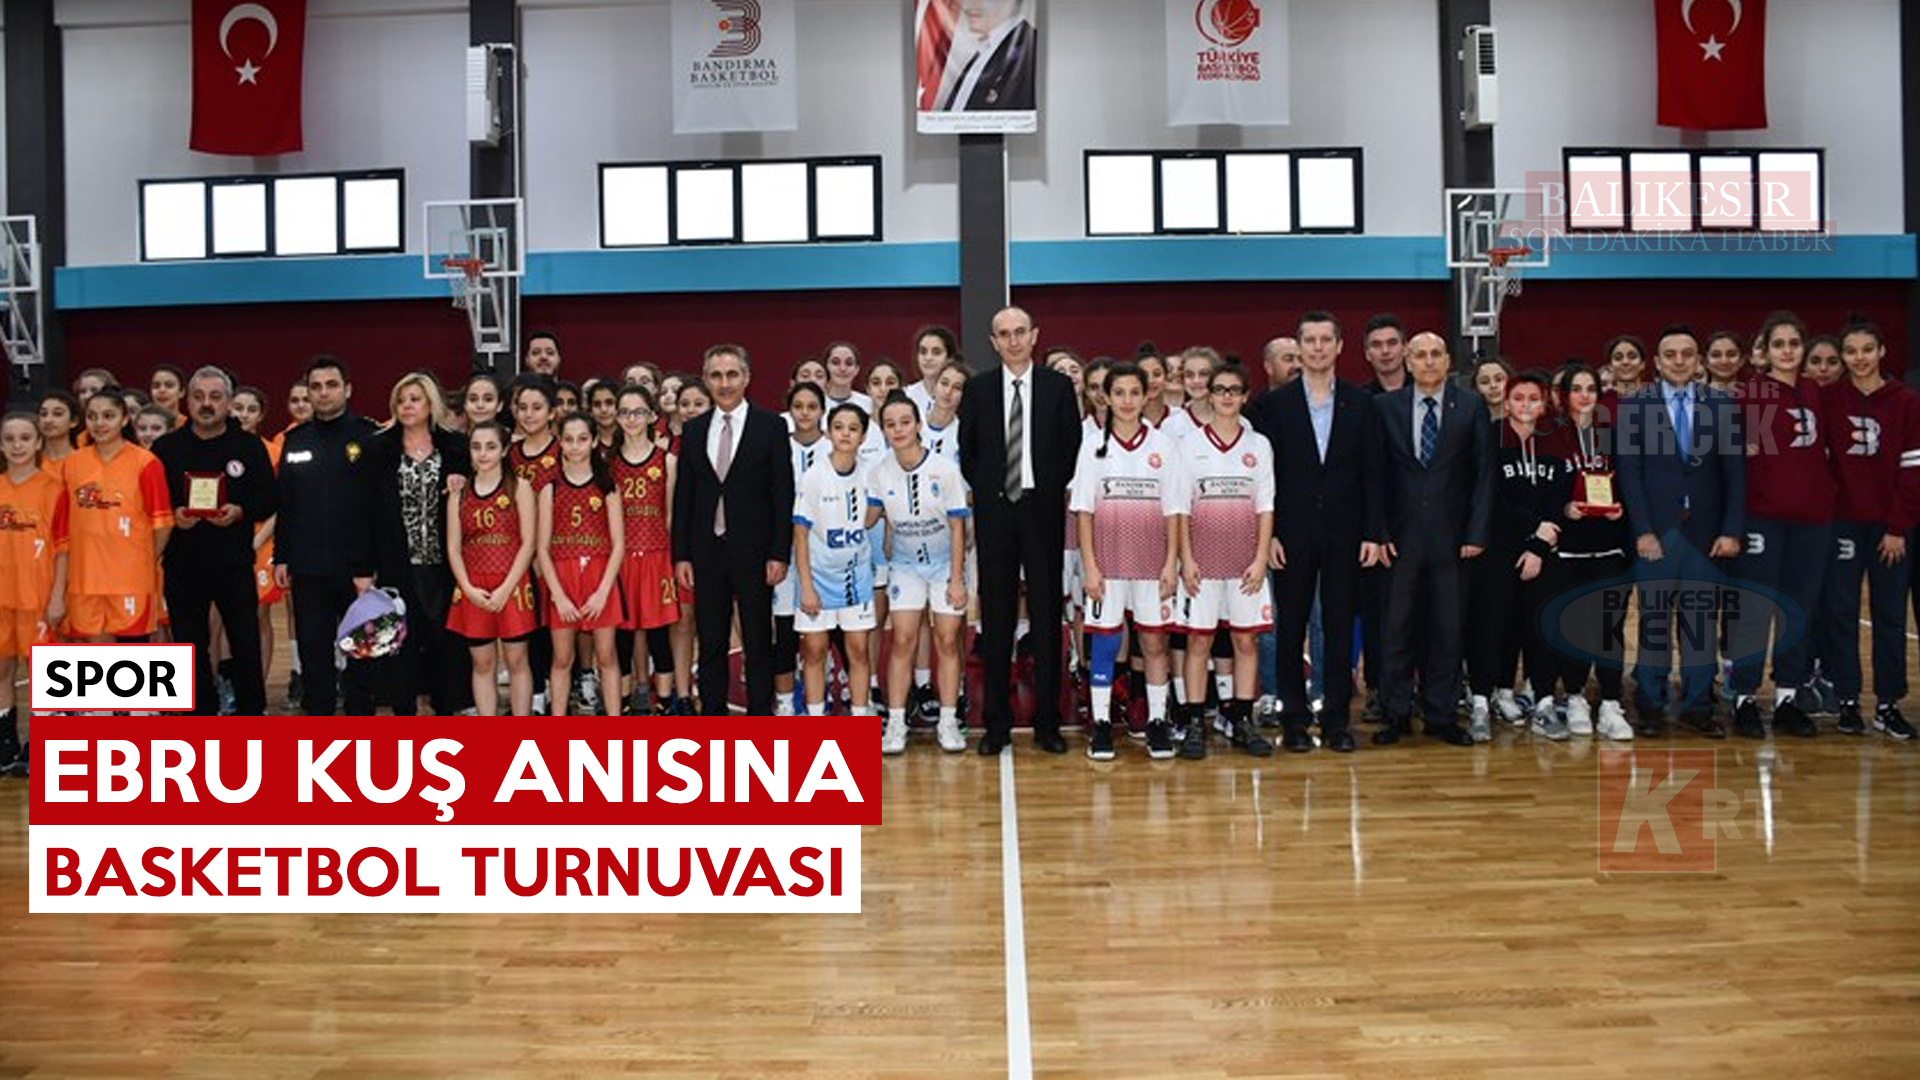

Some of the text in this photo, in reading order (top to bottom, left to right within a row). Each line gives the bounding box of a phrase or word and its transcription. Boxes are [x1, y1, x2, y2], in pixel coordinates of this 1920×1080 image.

[693, 59, 776, 72] BANDIRMA
[690, 70, 779, 83] BASKETBOL
[624, 477, 647, 499] 28
[119, 516, 131, 537] 4
[472, 507, 496, 528] 16
[570, 506, 583, 527] 5
[34, 538, 45, 559] 7
[513, 583, 534, 612] 16
